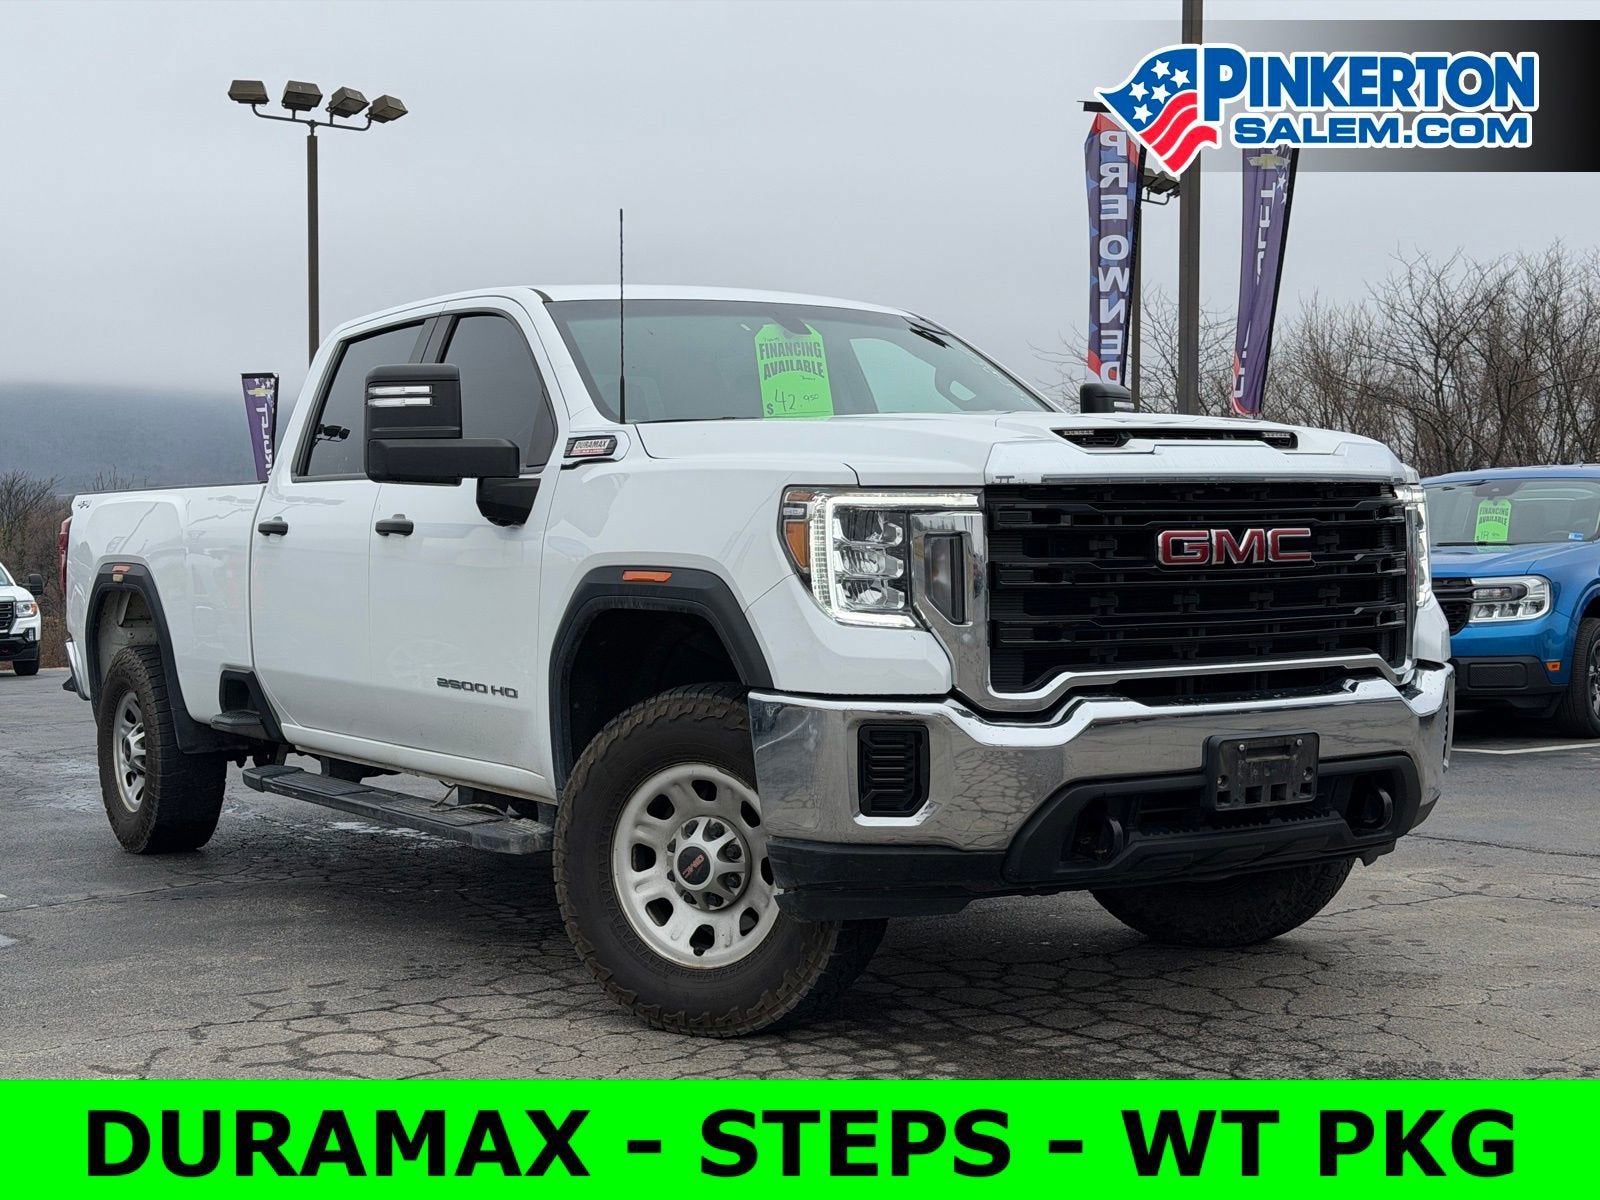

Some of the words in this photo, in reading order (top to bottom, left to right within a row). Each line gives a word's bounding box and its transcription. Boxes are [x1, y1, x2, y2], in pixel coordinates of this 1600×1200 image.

[759, 342, 822, 360] FINANCING
[763, 360, 824, 380] AVAILABLE
[575, 440, 608, 449] DURAMAX
[1480, 507, 1509, 517] FINANCING
[1157, 528, 1312, 566] GMC
[437, 677, 489, 694] 2500
[491, 685, 519, 699] HD
